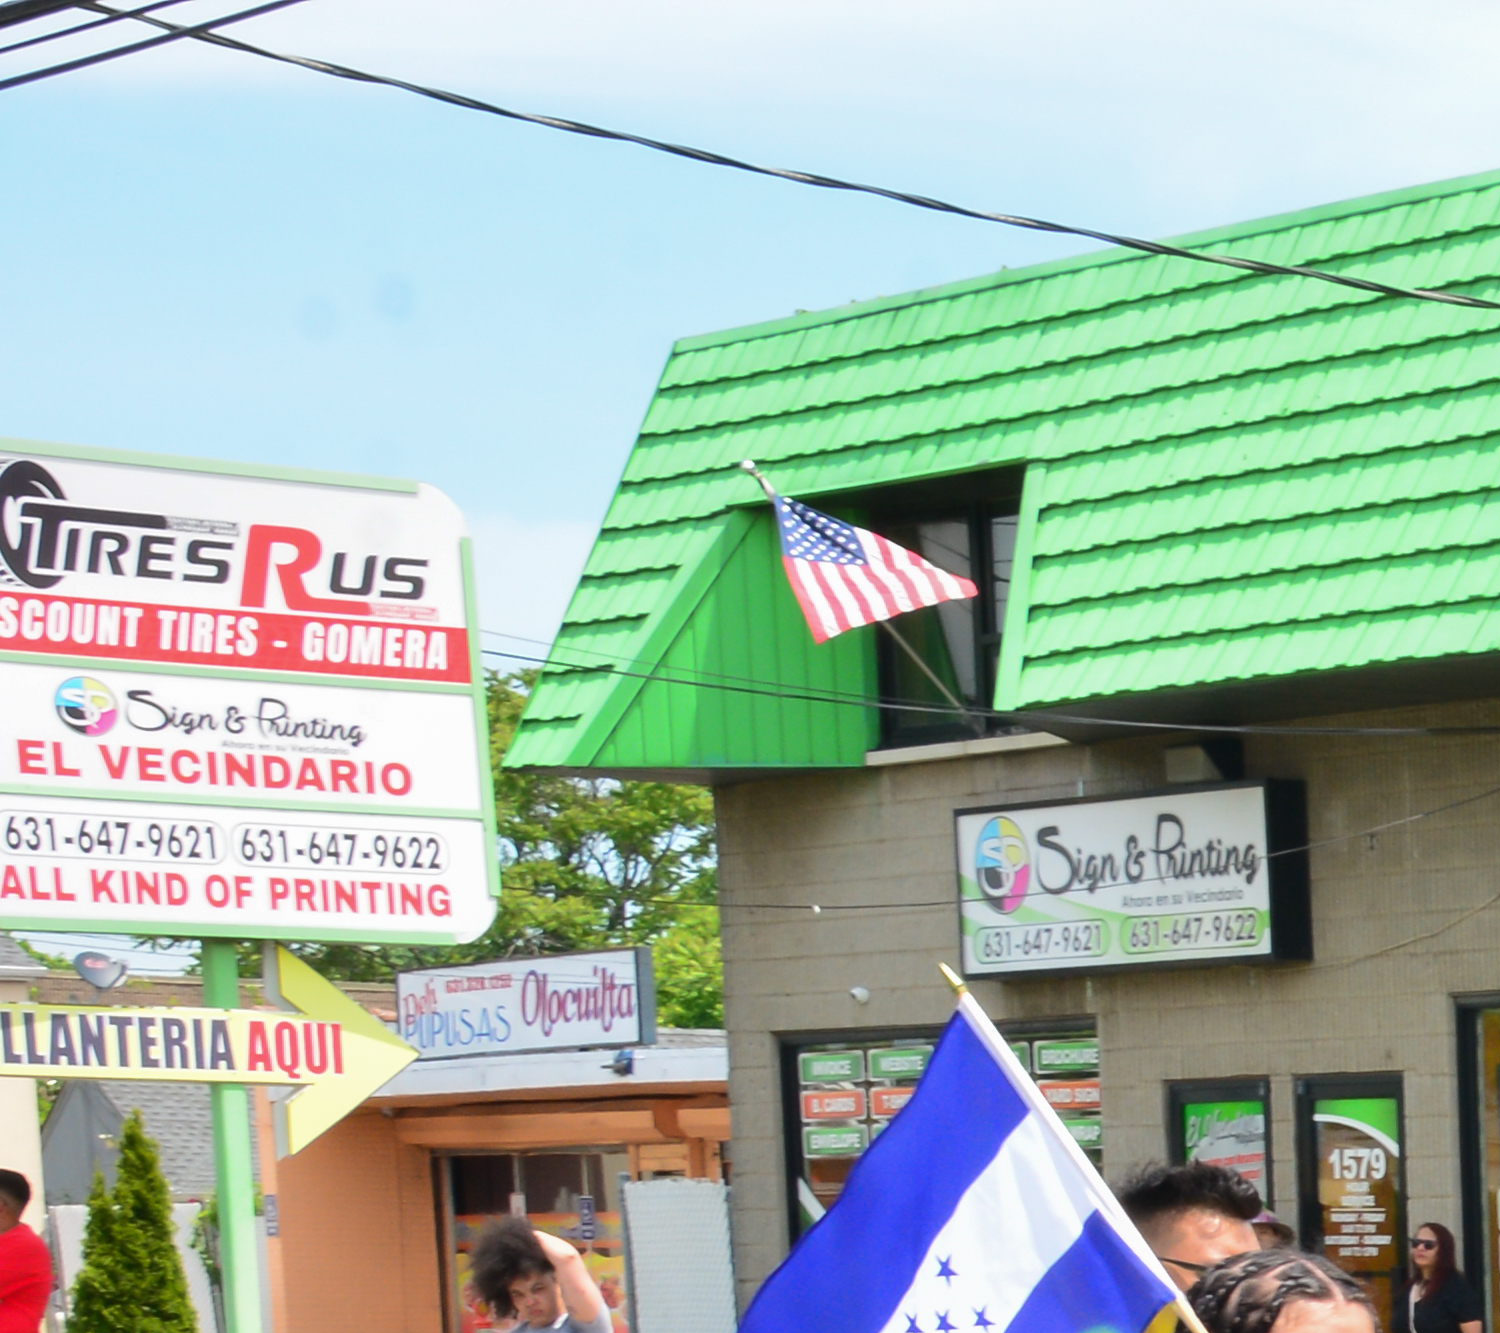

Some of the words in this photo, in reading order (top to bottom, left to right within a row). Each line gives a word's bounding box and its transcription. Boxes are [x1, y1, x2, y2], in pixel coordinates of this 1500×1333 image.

[21, 502, 235, 584] TIRES
[330, 552, 429, 600] US
[157, 609, 259, 656] TIRES
[302, 622, 448, 670] GOMERA
[126, 689, 218, 735] Sign
[224, 705, 247, 735] &
[253, 697, 367, 748] Printing
[17, 739, 82, 778] EL
[98, 744, 413, 797] VECINDARIO
[5, 816, 217, 860] 631-647-9621
[241, 828, 442, 870] 631-647-9622
[1036, 825, 1120, 894] Sign
[1125, 834, 1146, 883] &
[1151, 813, 1260, 885] Printing
[1, 864, 76, 902] ALL
[90, 868, 189, 907] KIND
[205, 874, 254, 909] OF
[269, 877, 453, 917] PRINTING
[983, 924, 1102, 958] 631-647-9621
[1129, 913, 1258, 949] 631-647-9622
[0, 1011, 236, 1072] LLANTERIA
[248, 1020, 344, 1079] AQUI
[1328, 1147, 1387, 1179] 1579
